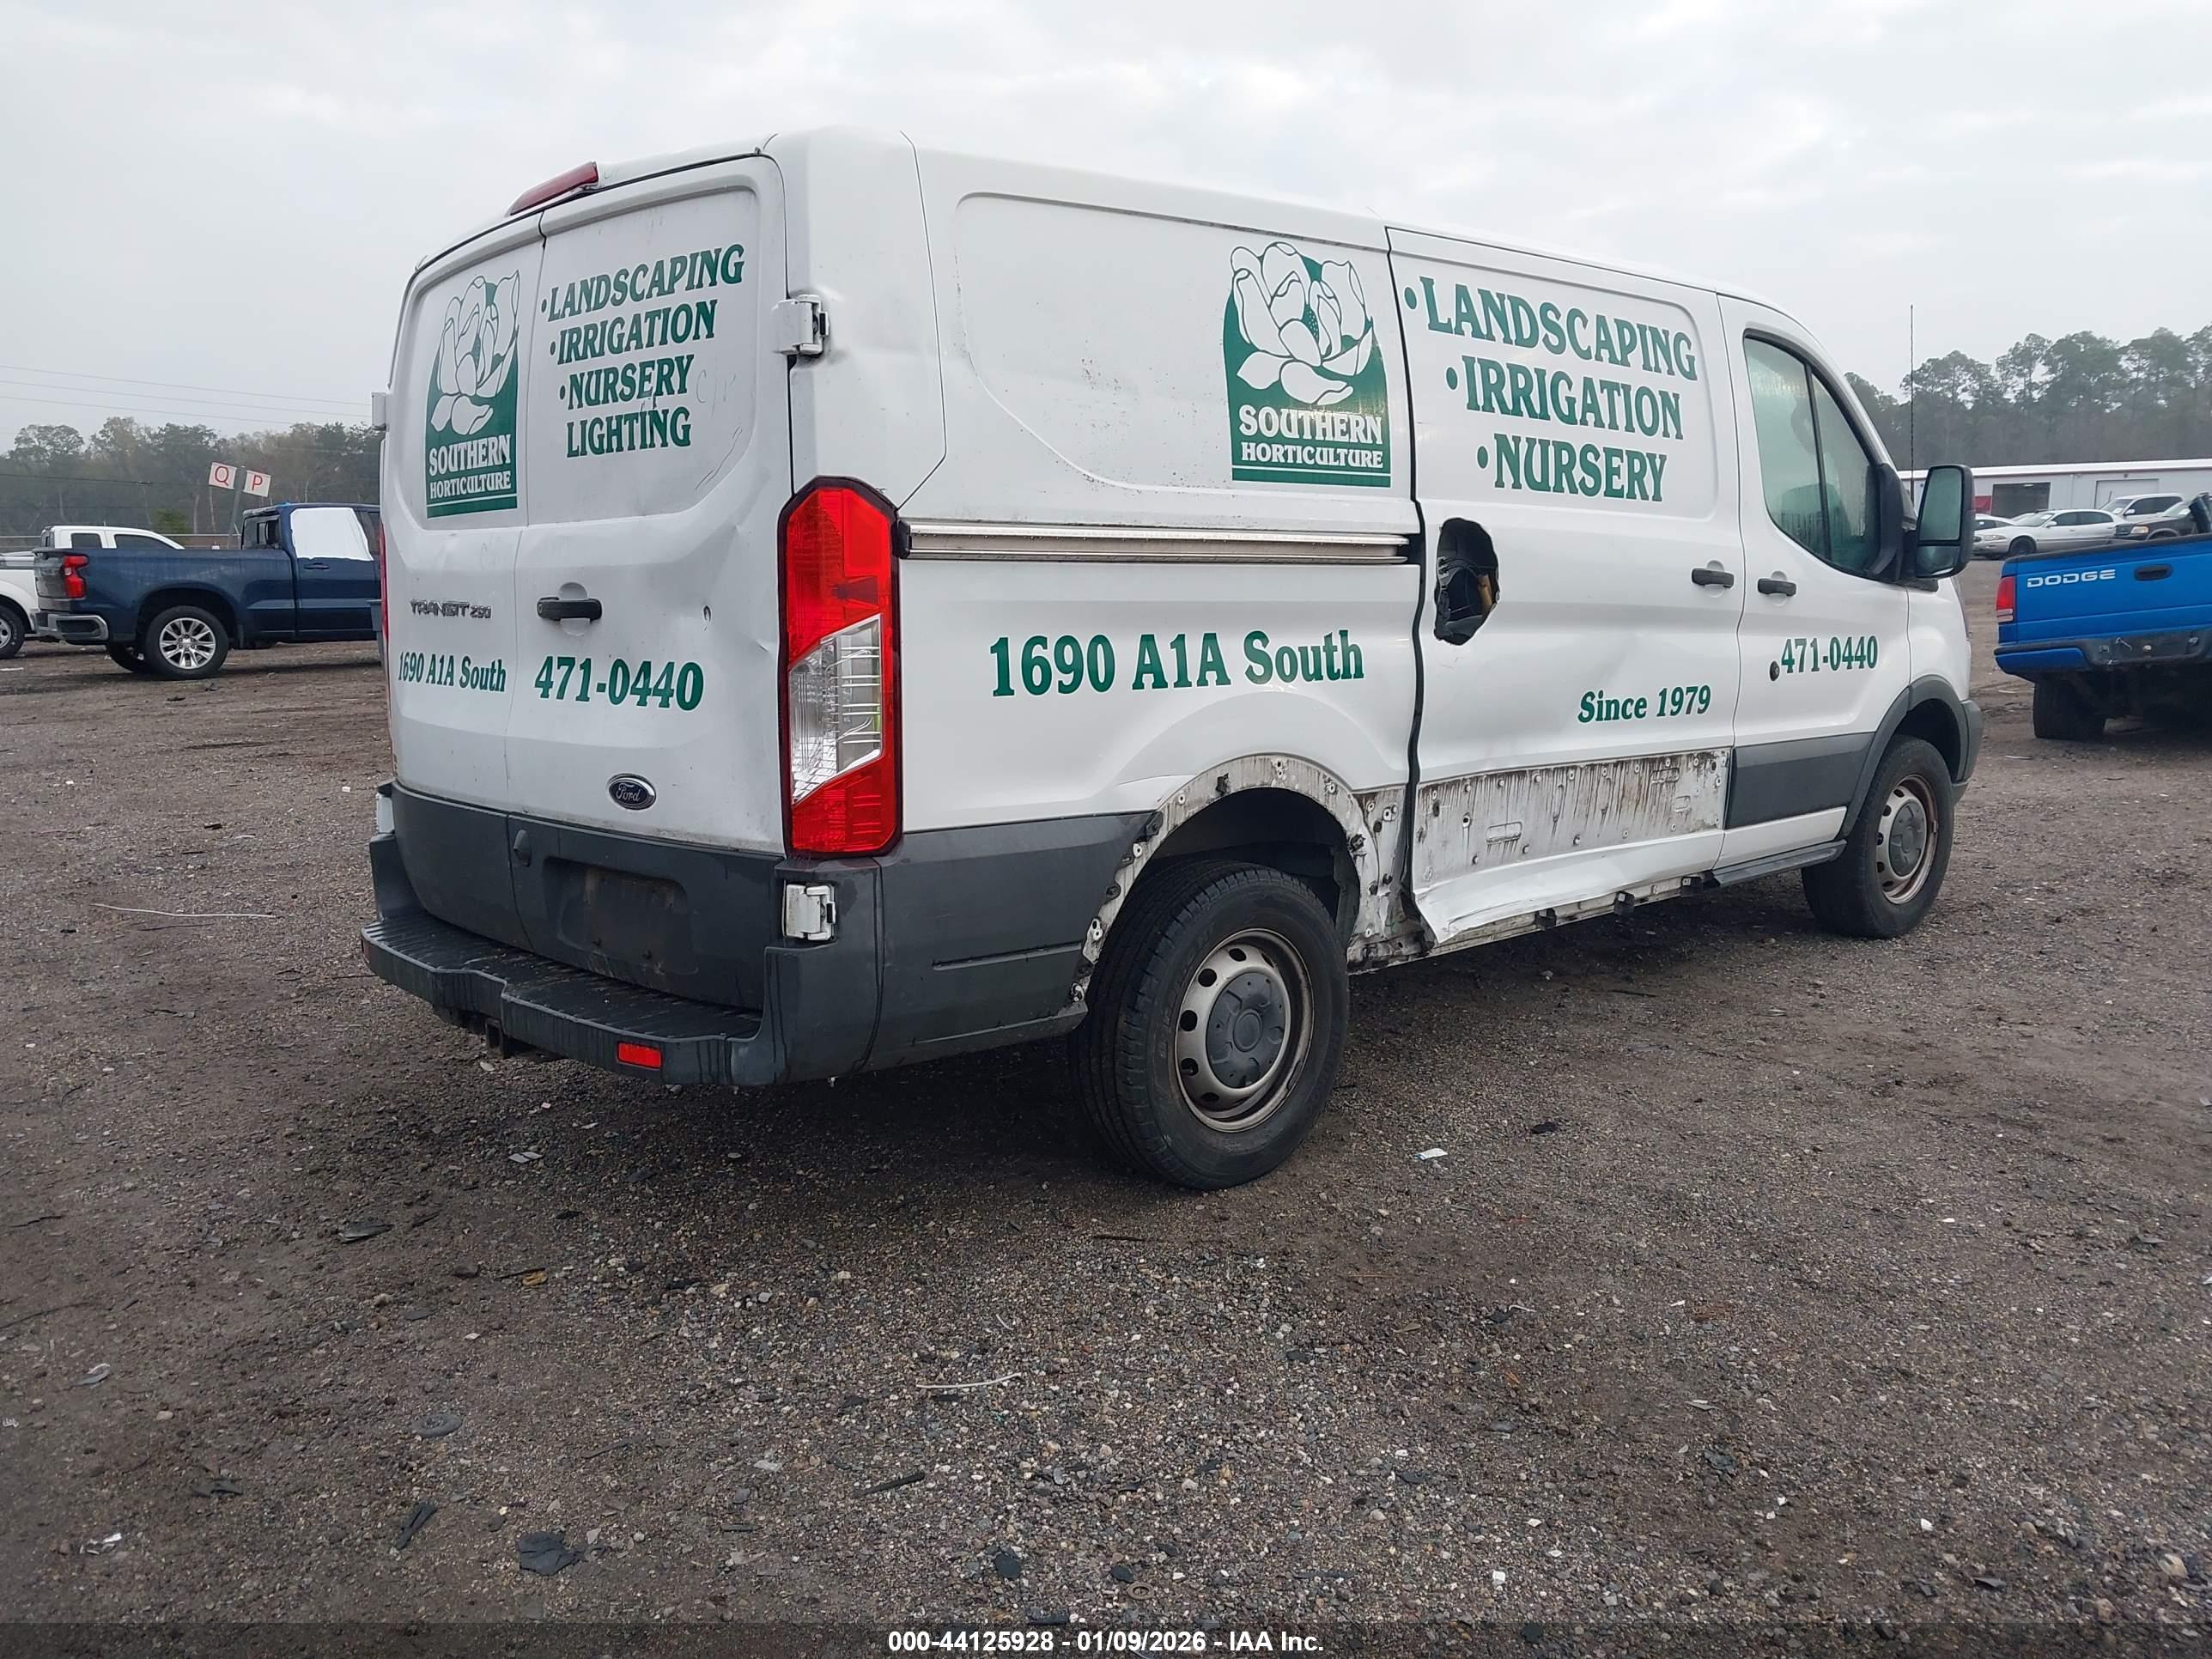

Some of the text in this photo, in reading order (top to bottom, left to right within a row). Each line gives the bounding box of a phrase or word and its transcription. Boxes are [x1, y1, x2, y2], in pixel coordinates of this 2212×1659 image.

[547, 243, 744, 322] LANDSCAPING
[556, 299, 718, 365] IRRIGATION
[1419, 275, 1698, 381] LANDSCAPING
[567, 354, 694, 410] NURSERY
[1462, 355, 1684, 441] IRRIGATION
[566, 406, 691, 458] LIGHTING
[1239, 404, 1383, 445] SOUTHERN
[429, 434, 511, 477] SOUTHERN
[1241, 441, 1384, 469] HORTICULTURE
[1493, 433, 1668, 502] NURSERY
[215, 465, 229, 487] Q
[252, 474, 263, 491] P
[430, 470, 512, 499] HORTICULTURE
[2027, 568, 2116, 588] DODGE
[410, 599, 470, 617] TRANSIT
[398, 651, 507, 692] 1690 A1A South
[990, 629, 1364, 697] 1690 A1A South
[1781, 635, 1878, 674] 471-0440
[534, 655, 704, 711] 471-0440
[1577, 684, 1711, 723] Since 1979
[616, 782, 641, 802] Ford
